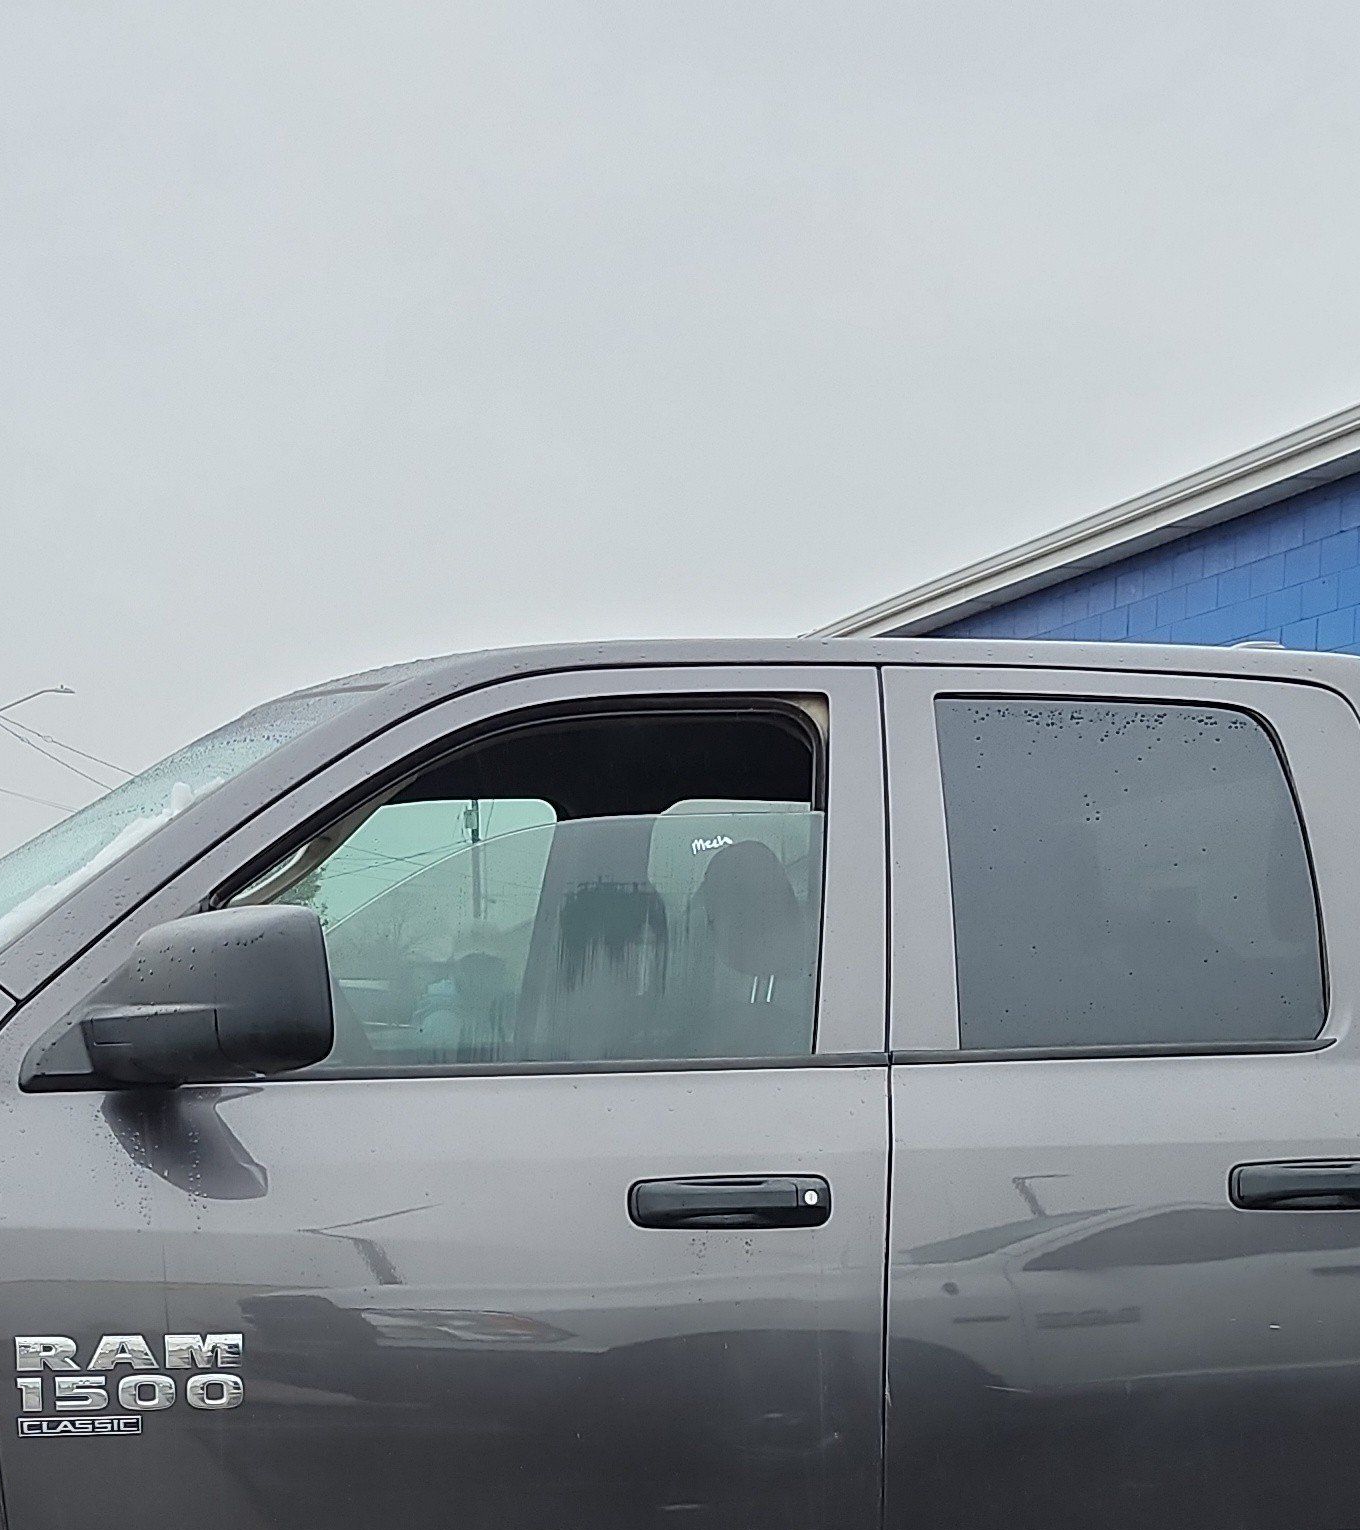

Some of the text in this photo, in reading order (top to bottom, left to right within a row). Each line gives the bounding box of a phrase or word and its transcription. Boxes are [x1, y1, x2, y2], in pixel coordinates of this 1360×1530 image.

[14, 1333, 244, 1371] RAM
[16, 1373, 244, 1412] 1500
[22, 1418, 139, 1435] CLASSIC
